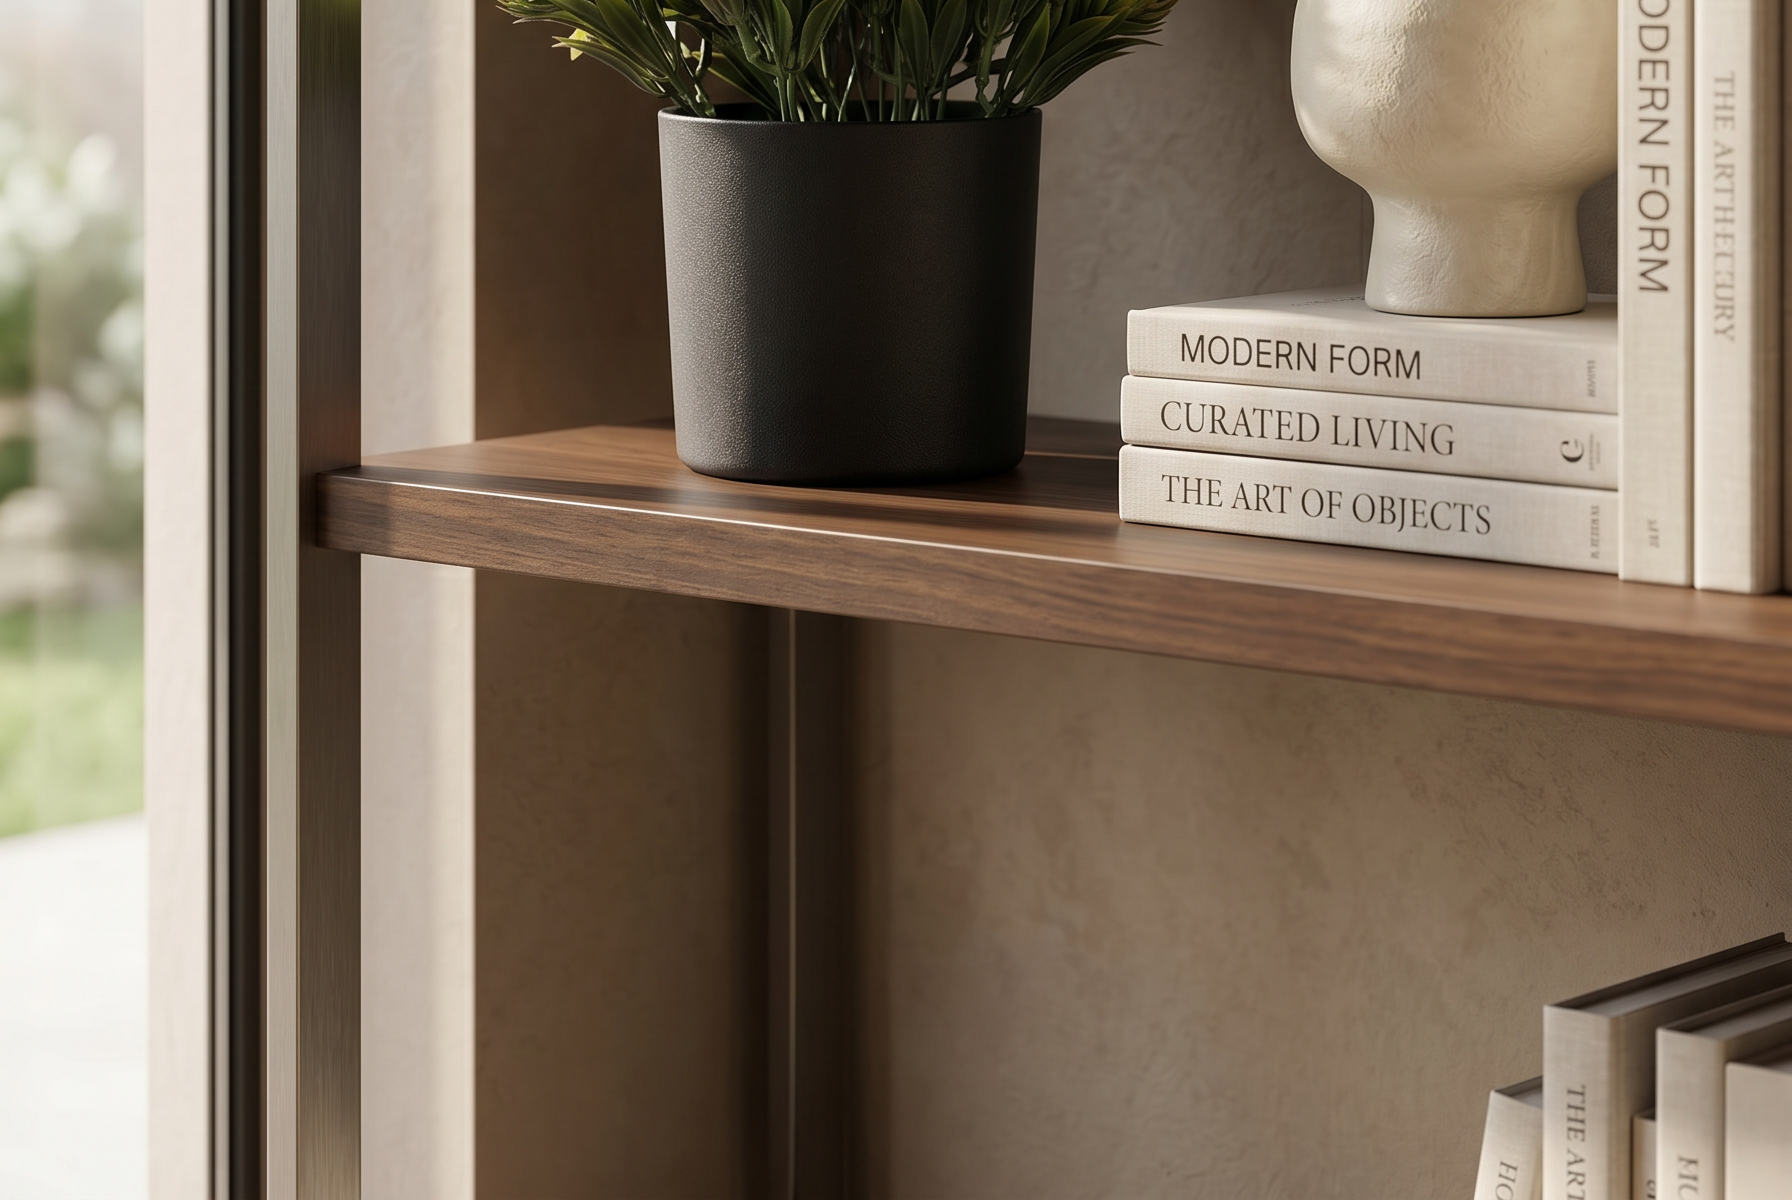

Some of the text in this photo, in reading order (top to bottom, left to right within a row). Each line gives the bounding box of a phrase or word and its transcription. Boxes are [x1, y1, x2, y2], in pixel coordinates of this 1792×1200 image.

[1714, 70, 1735, 132] THE
[1639, 164, 1670, 293] FORM
[1180, 333, 1421, 380] MODERN FORM
[1160, 400, 1455, 456] CURATED LIVING
[1161, 473, 1491, 535] THE ART OF OBJECTS
[1566, 1084, 1586, 1142] THE
